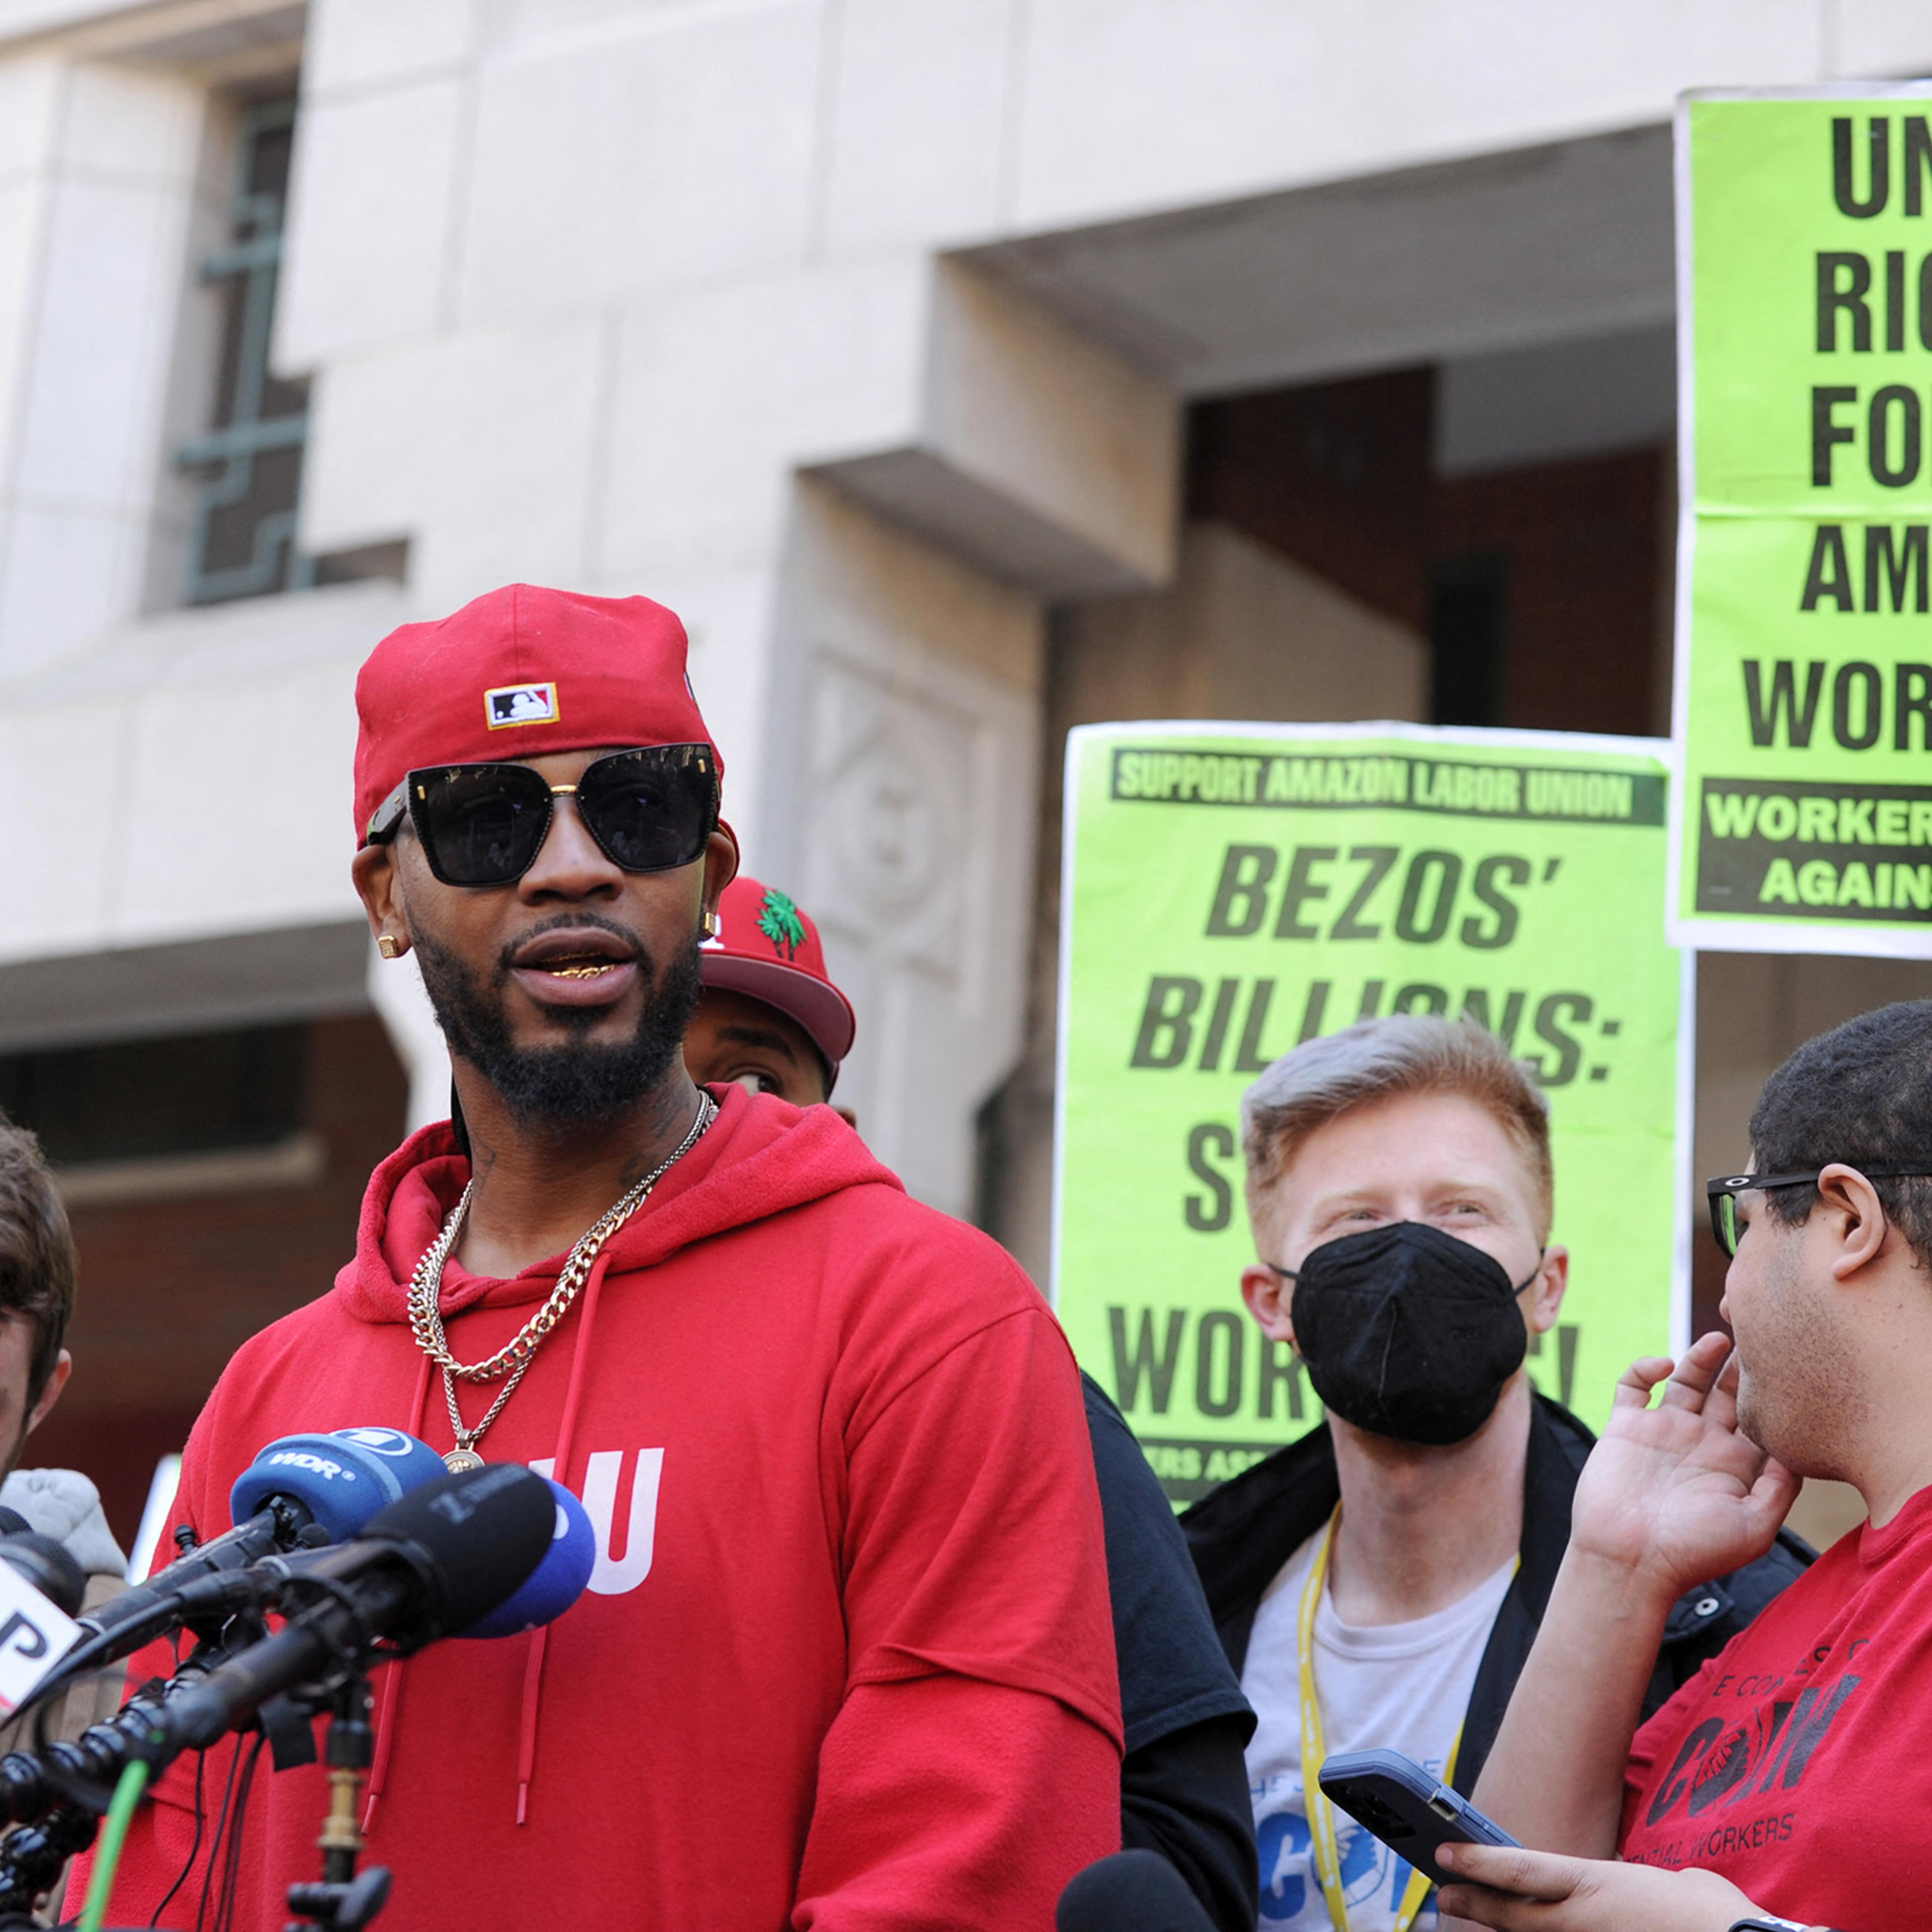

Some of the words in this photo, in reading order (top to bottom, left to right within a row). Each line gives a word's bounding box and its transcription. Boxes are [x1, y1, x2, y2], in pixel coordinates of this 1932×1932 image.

[1815, 251, 1932, 353] RI
[1812, 384, 1932, 489] FO
[1742, 660, 1932, 751] WOR
[1116, 752, 1262, 804] SUPPORT
[1263, 756, 1409, 804] AMAZON
[1413, 759, 1520, 813] LABOR
[1526, 769, 1633, 819] UNION
[1204, 843, 1563, 949] BEZOS'
[1758, 858, 1932, 910] AGAIN
[1691, 1813, 1795, 1859] WORKERS
